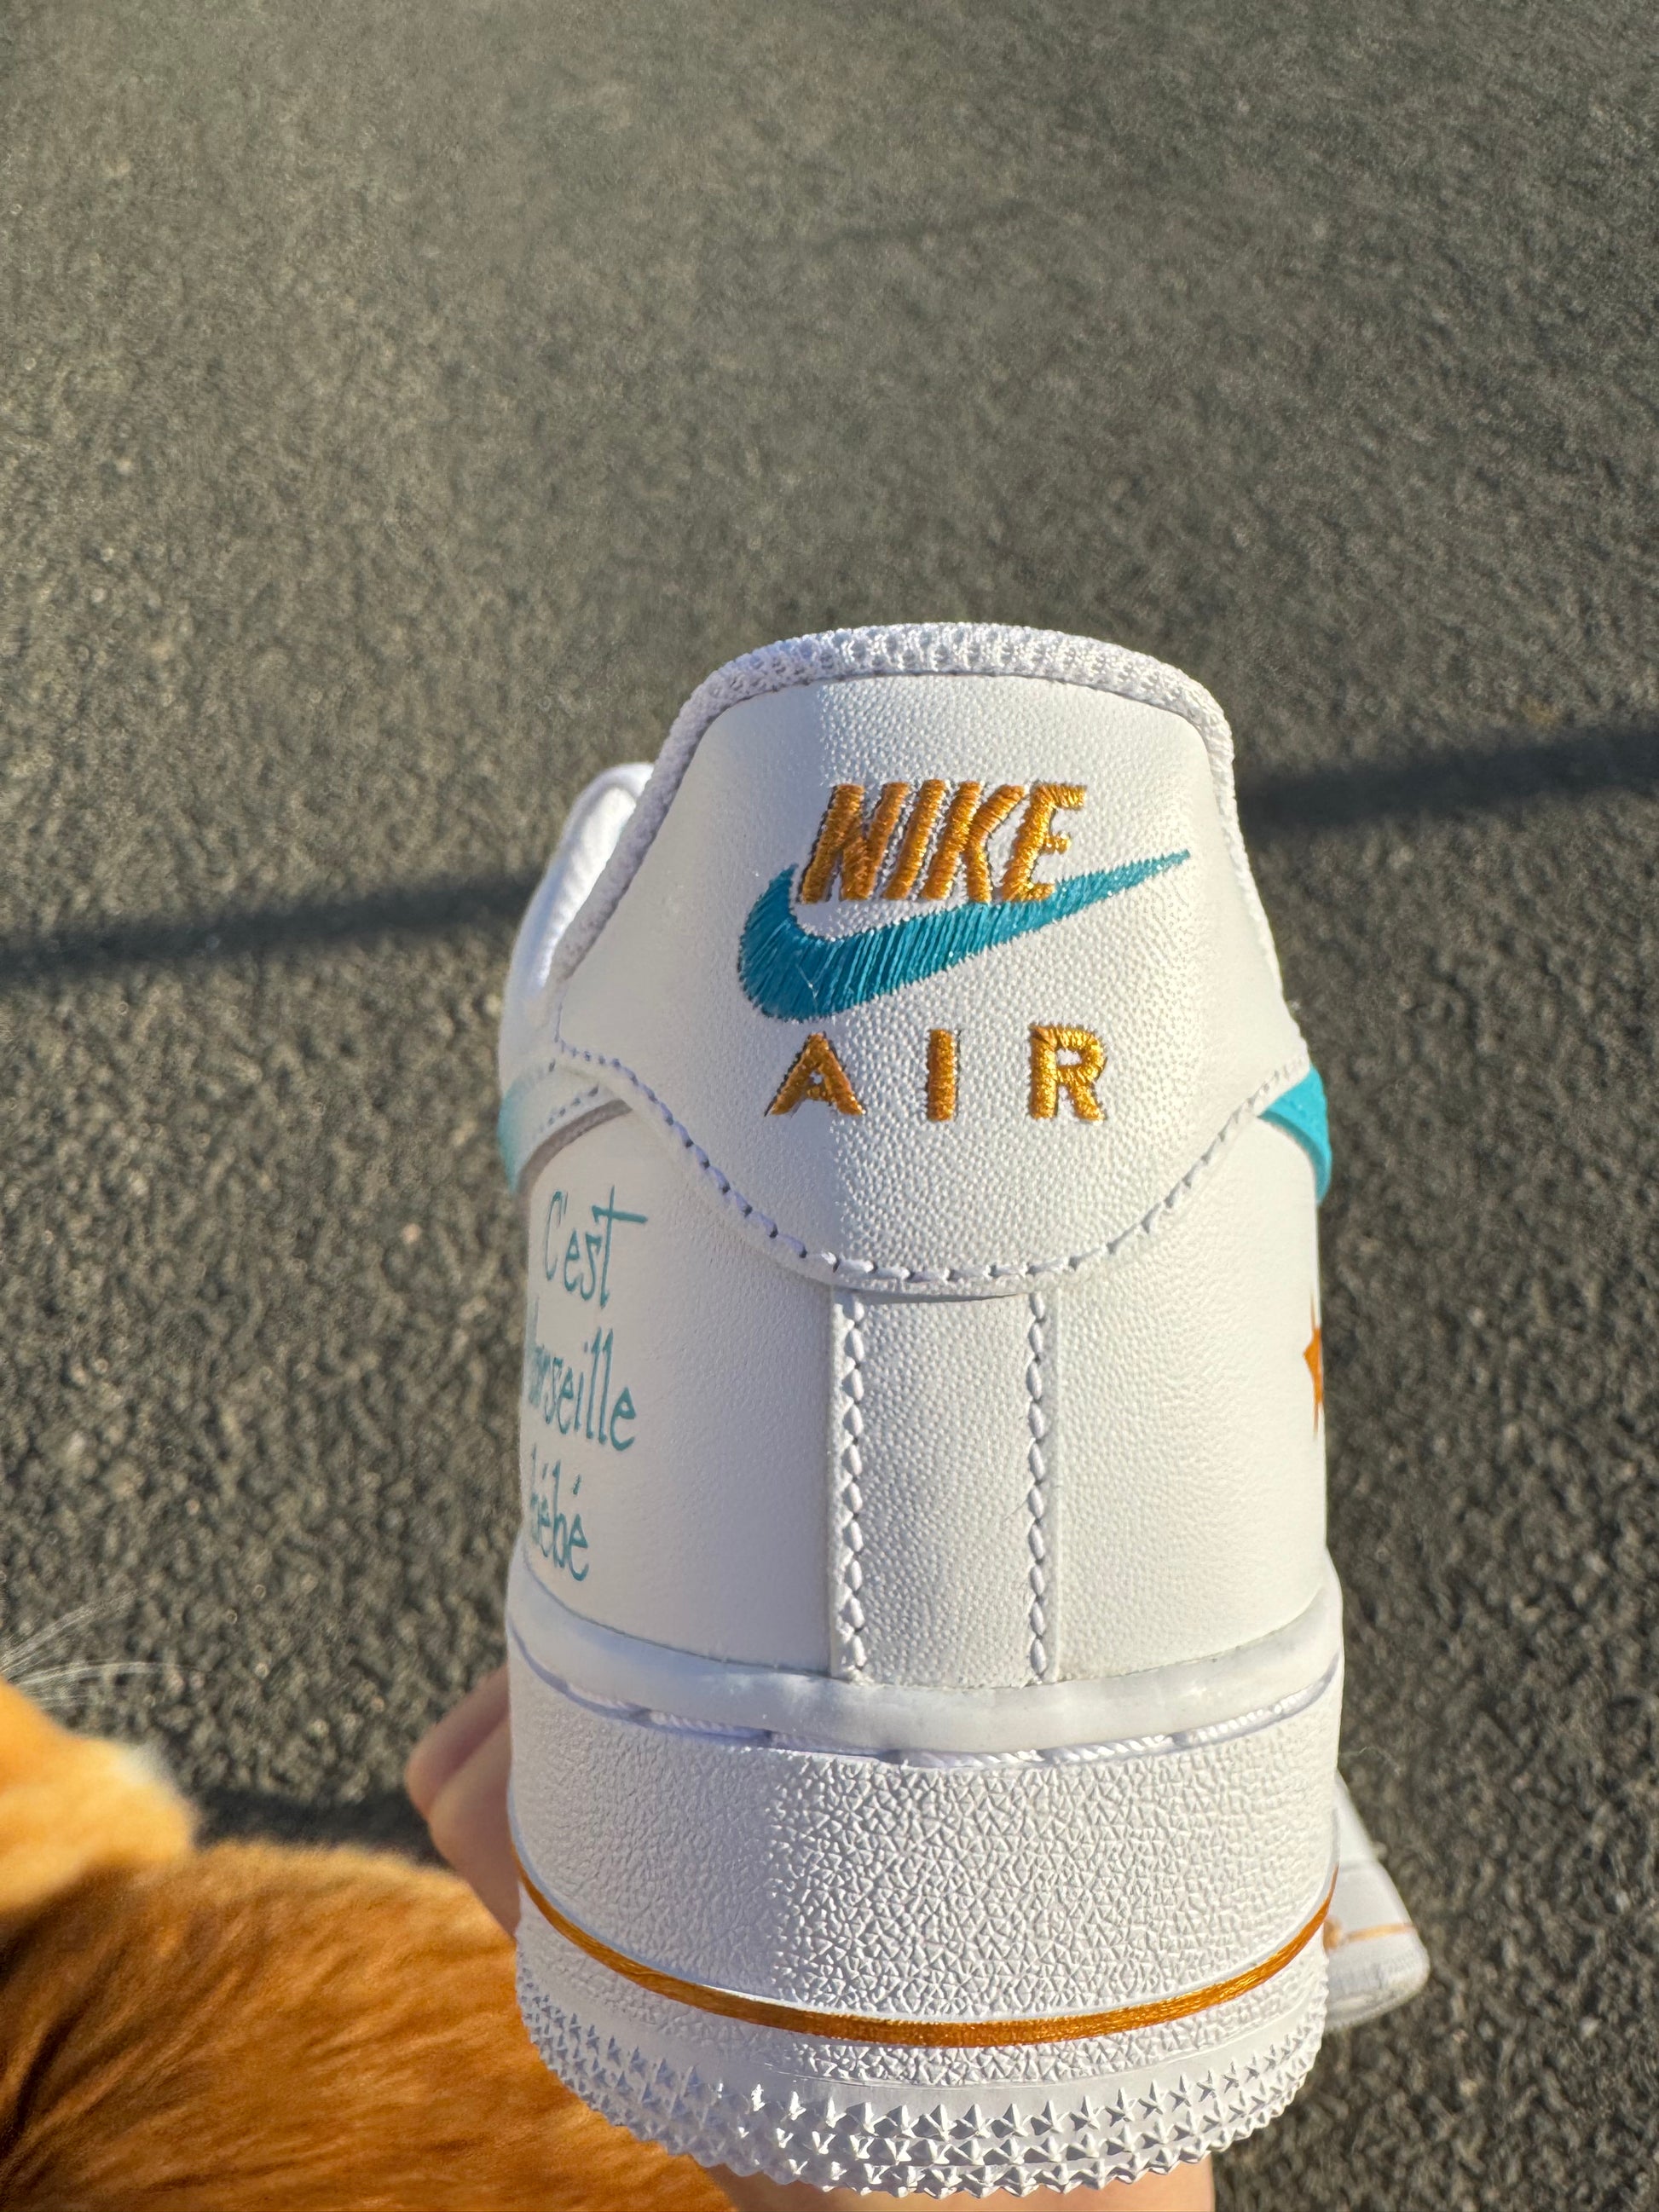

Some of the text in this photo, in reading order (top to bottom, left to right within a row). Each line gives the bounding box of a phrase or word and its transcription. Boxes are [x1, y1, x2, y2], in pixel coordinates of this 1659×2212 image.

[800, 779, 1087, 904] NIKE
[766, 1025, 1108, 1123] AIR
[542, 1184, 649, 1309] C'est
